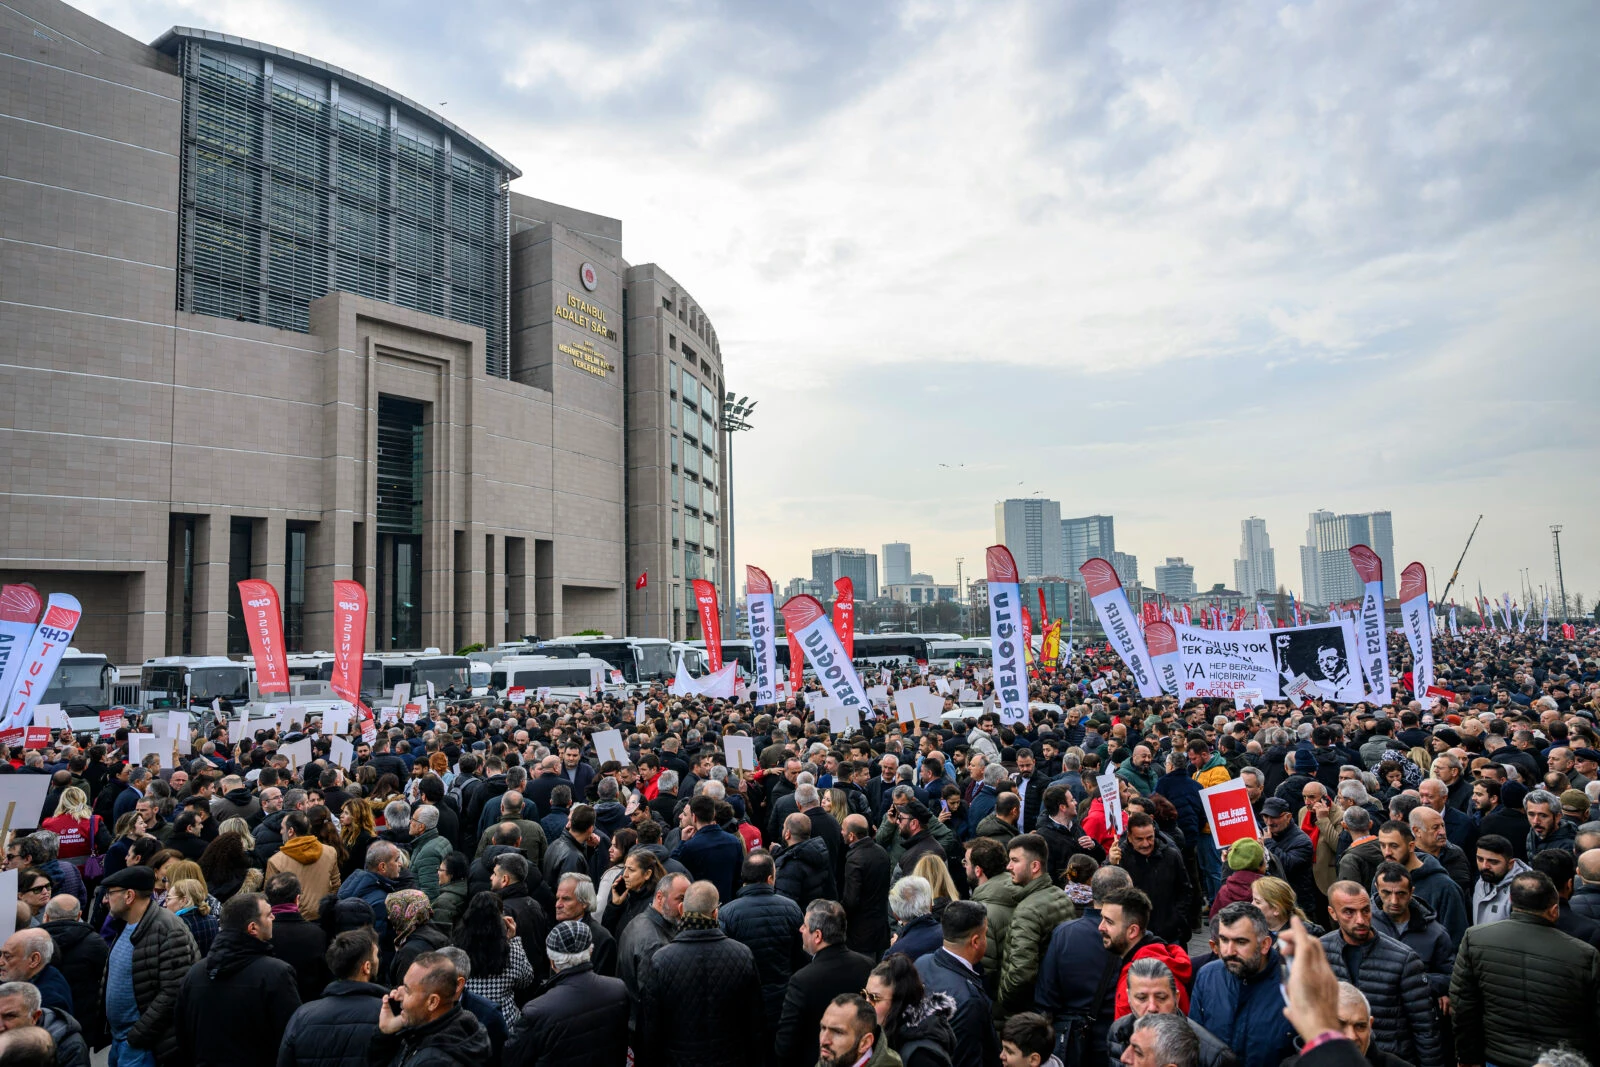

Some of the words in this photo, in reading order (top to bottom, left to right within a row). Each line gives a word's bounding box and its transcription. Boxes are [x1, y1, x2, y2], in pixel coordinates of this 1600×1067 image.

[568, 292, 607, 322] İSTANBUL
[555, 305, 590, 328] ADALET
[591, 321, 617, 342] SARAYI
[558, 343, 583, 359] MEHMET
[1182, 645, 1202, 654] TEK
[1241, 643, 1268, 653] YOK
[1184, 662, 1205, 678] YA
[1209, 671, 1256, 681] HİÇBİRİMİZ
[1210, 681, 1245, 690] ESENLER
[1196, 688, 1230, 698] GENÇLİK
[1218, 811, 1230, 820] ASIL
[1230, 807, 1247, 818] İFADE
